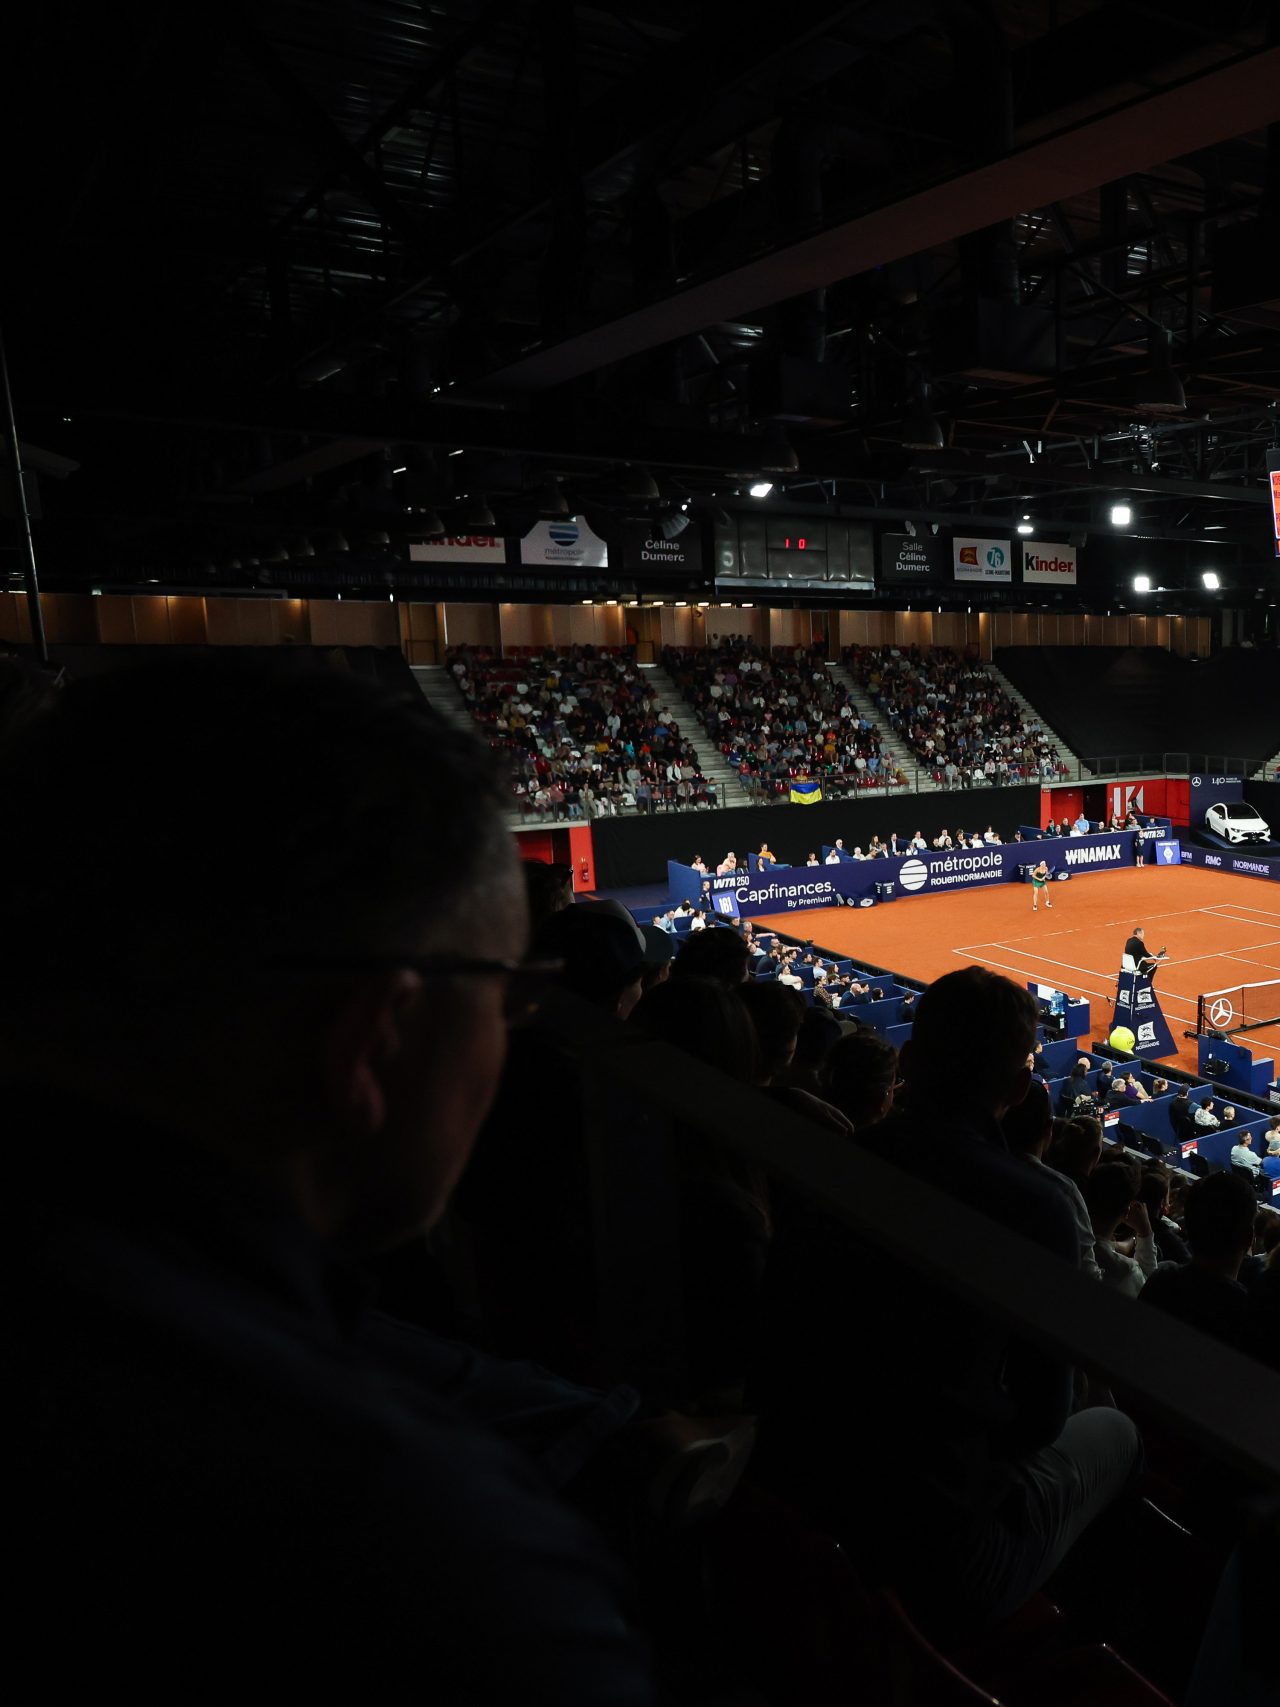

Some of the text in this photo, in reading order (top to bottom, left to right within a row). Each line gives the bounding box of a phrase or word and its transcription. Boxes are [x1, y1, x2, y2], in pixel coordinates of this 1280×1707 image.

[645, 538, 680, 551] Céline
[785, 537, 807, 549] 1 0
[902, 541, 923, 552] Salle
[641, 551, 685, 563] Dumerc
[899, 551, 927, 562] Céline
[895, 562, 930, 572] Dumerc
[1065, 844, 1121, 865] WINAMAX
[1205, 855, 1221, 866] RMC
[931, 851, 1003, 875] métropole
[713, 876, 750, 889] WTA 250
[787, 896, 832, 909] By Premium
